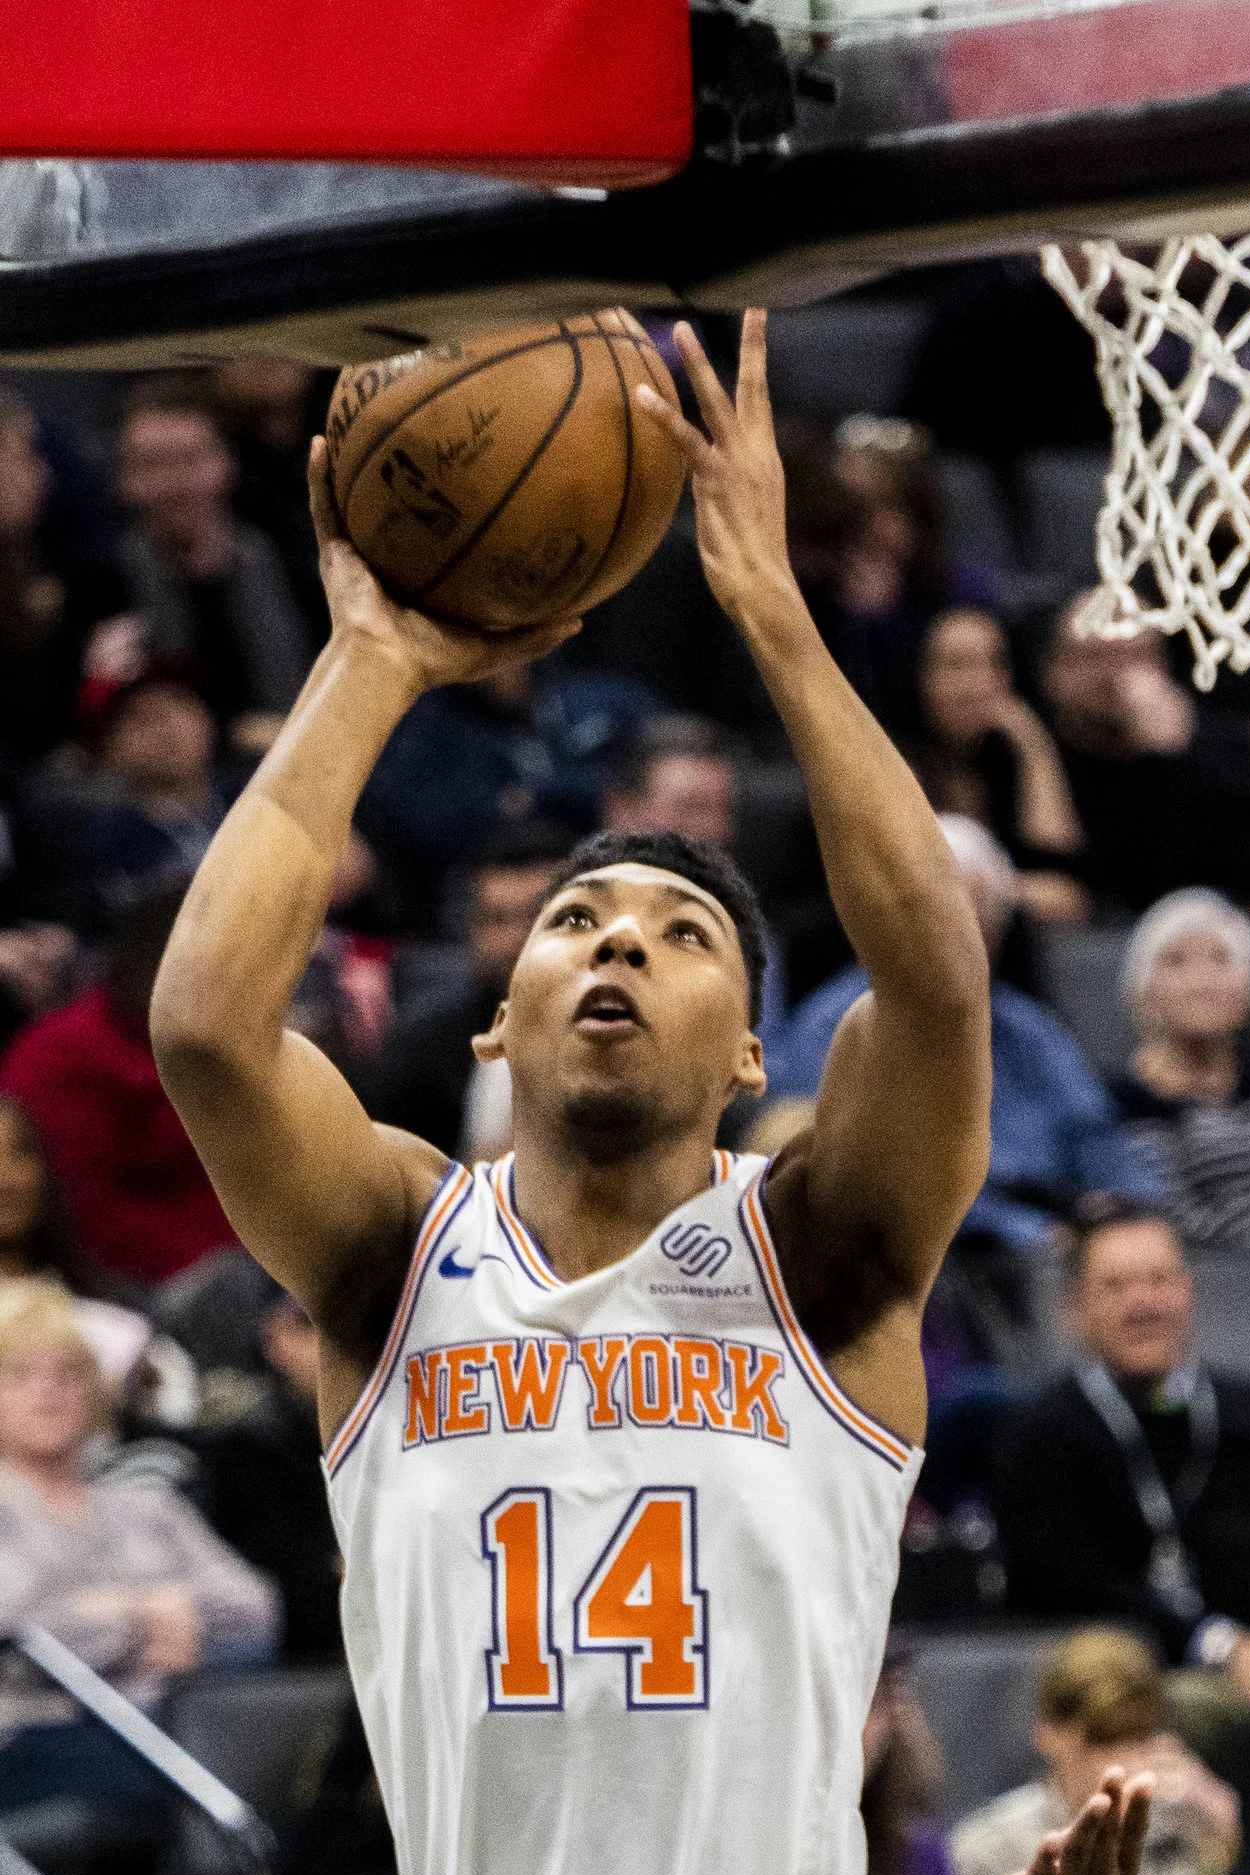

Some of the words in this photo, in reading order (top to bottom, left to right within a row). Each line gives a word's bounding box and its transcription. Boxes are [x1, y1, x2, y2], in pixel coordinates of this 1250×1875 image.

[649, 1283, 752, 1298] SQUARESPACE
[401, 1336, 571, 1452] NEW
[575, 1332, 791, 1449] YORK
[480, 1485, 710, 1712] 14
